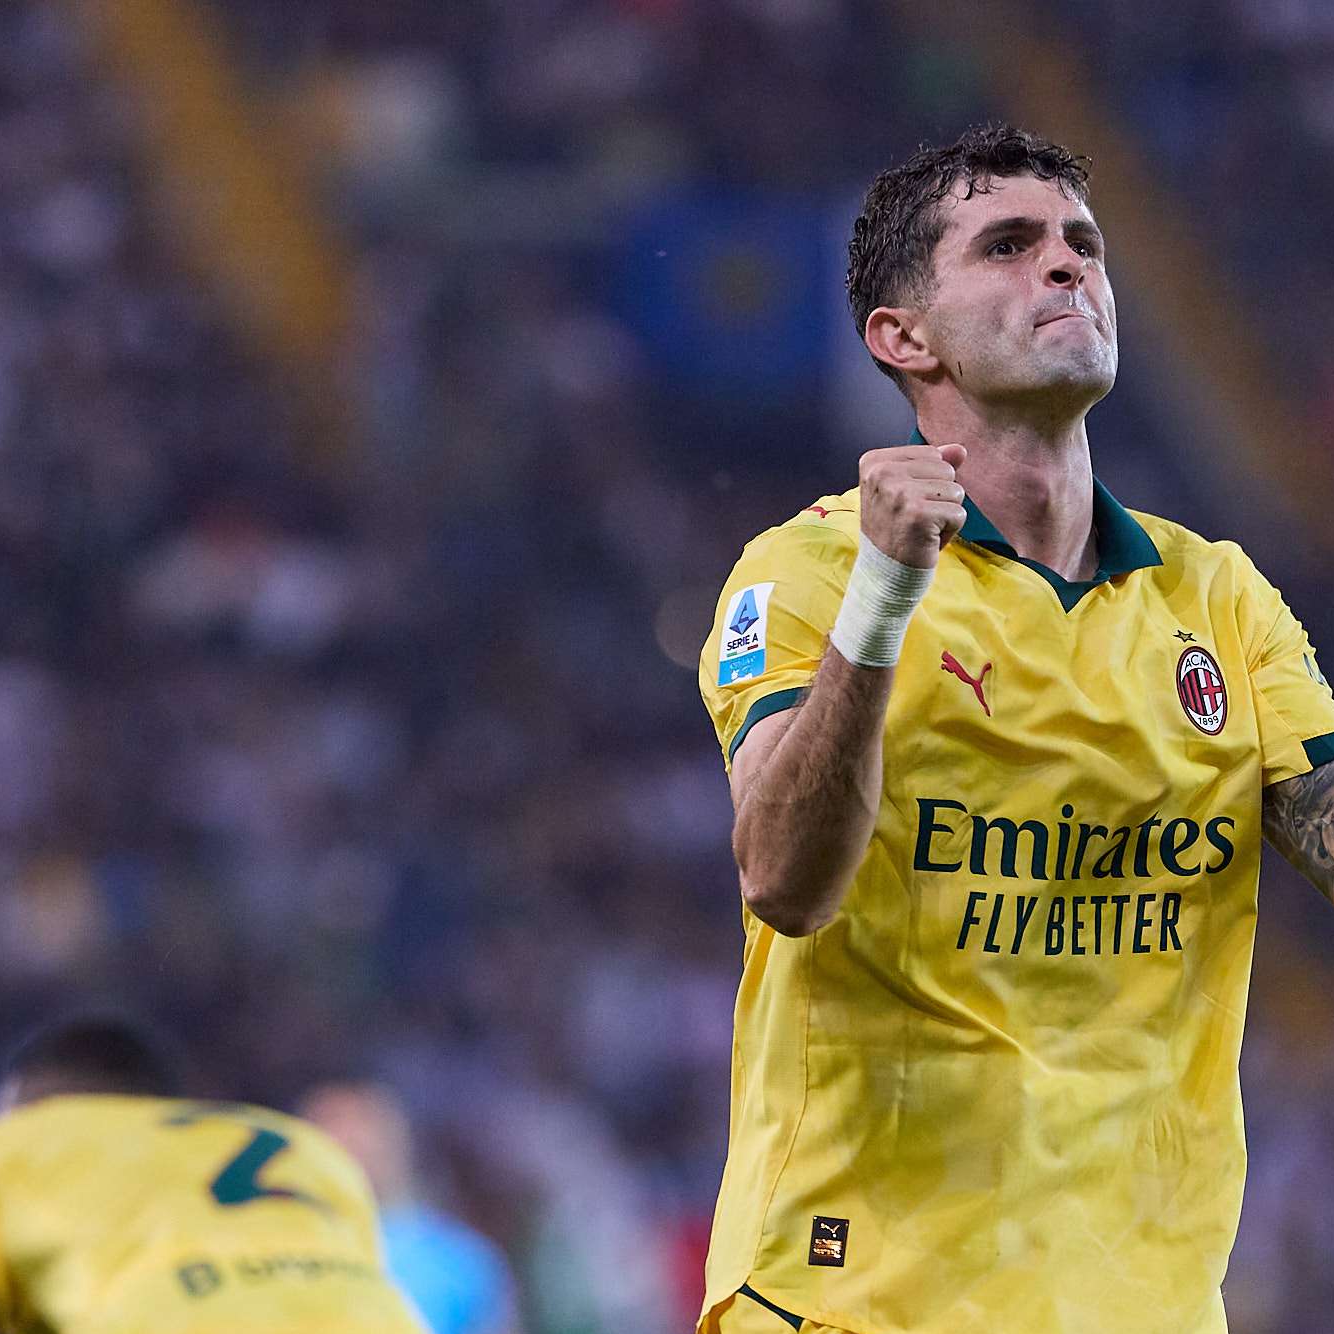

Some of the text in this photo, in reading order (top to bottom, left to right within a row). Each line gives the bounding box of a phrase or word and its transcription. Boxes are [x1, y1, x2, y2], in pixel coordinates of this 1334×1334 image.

[726, 632, 759, 651] SERIE A
[1184, 654, 1211, 672] ACM
[1197, 715, 1220, 726] 1899
[913, 798, 1236, 881] Emirates
[956, 891, 1183, 956] FLY BETTER
